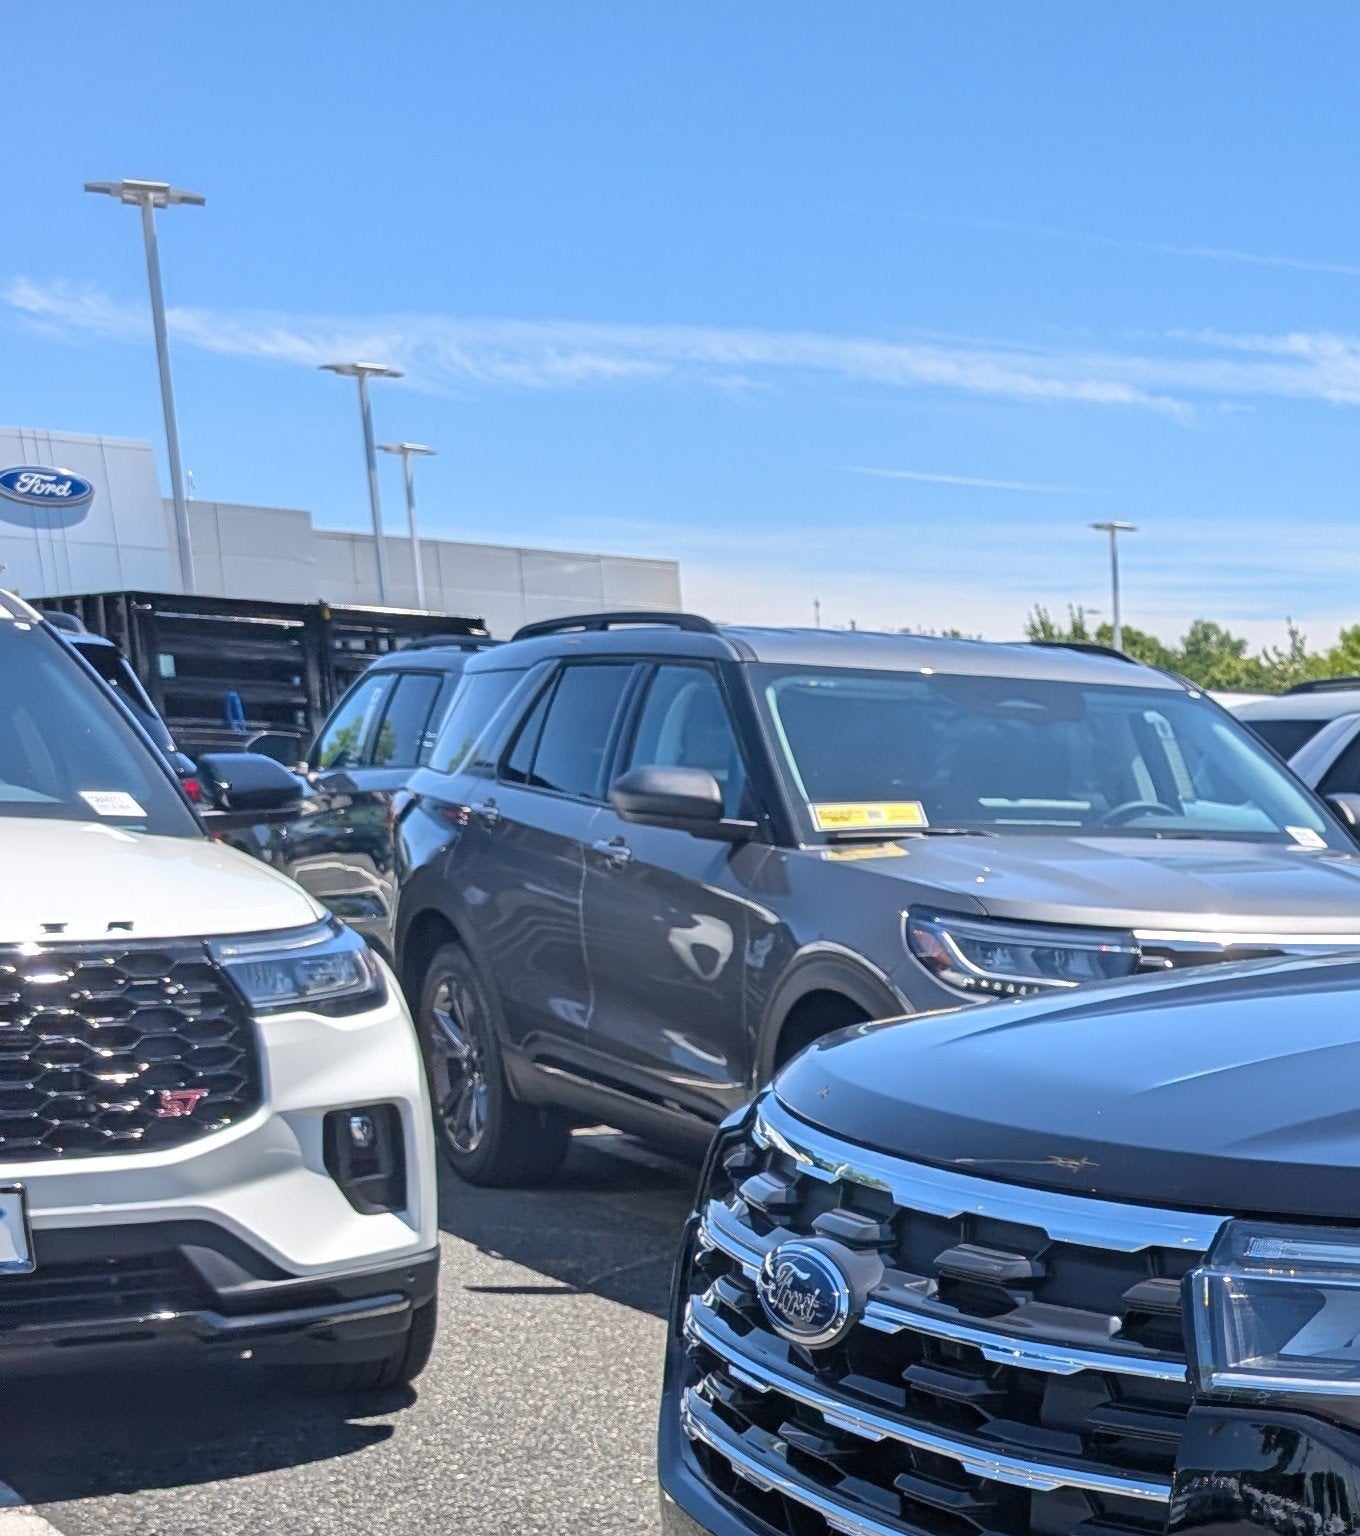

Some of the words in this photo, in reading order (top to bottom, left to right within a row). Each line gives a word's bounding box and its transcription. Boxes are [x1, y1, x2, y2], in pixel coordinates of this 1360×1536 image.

[15, 473, 73, 497] Ford
[157, 1088, 209, 1117] ST
[769, 1261, 821, 1323] Ford
